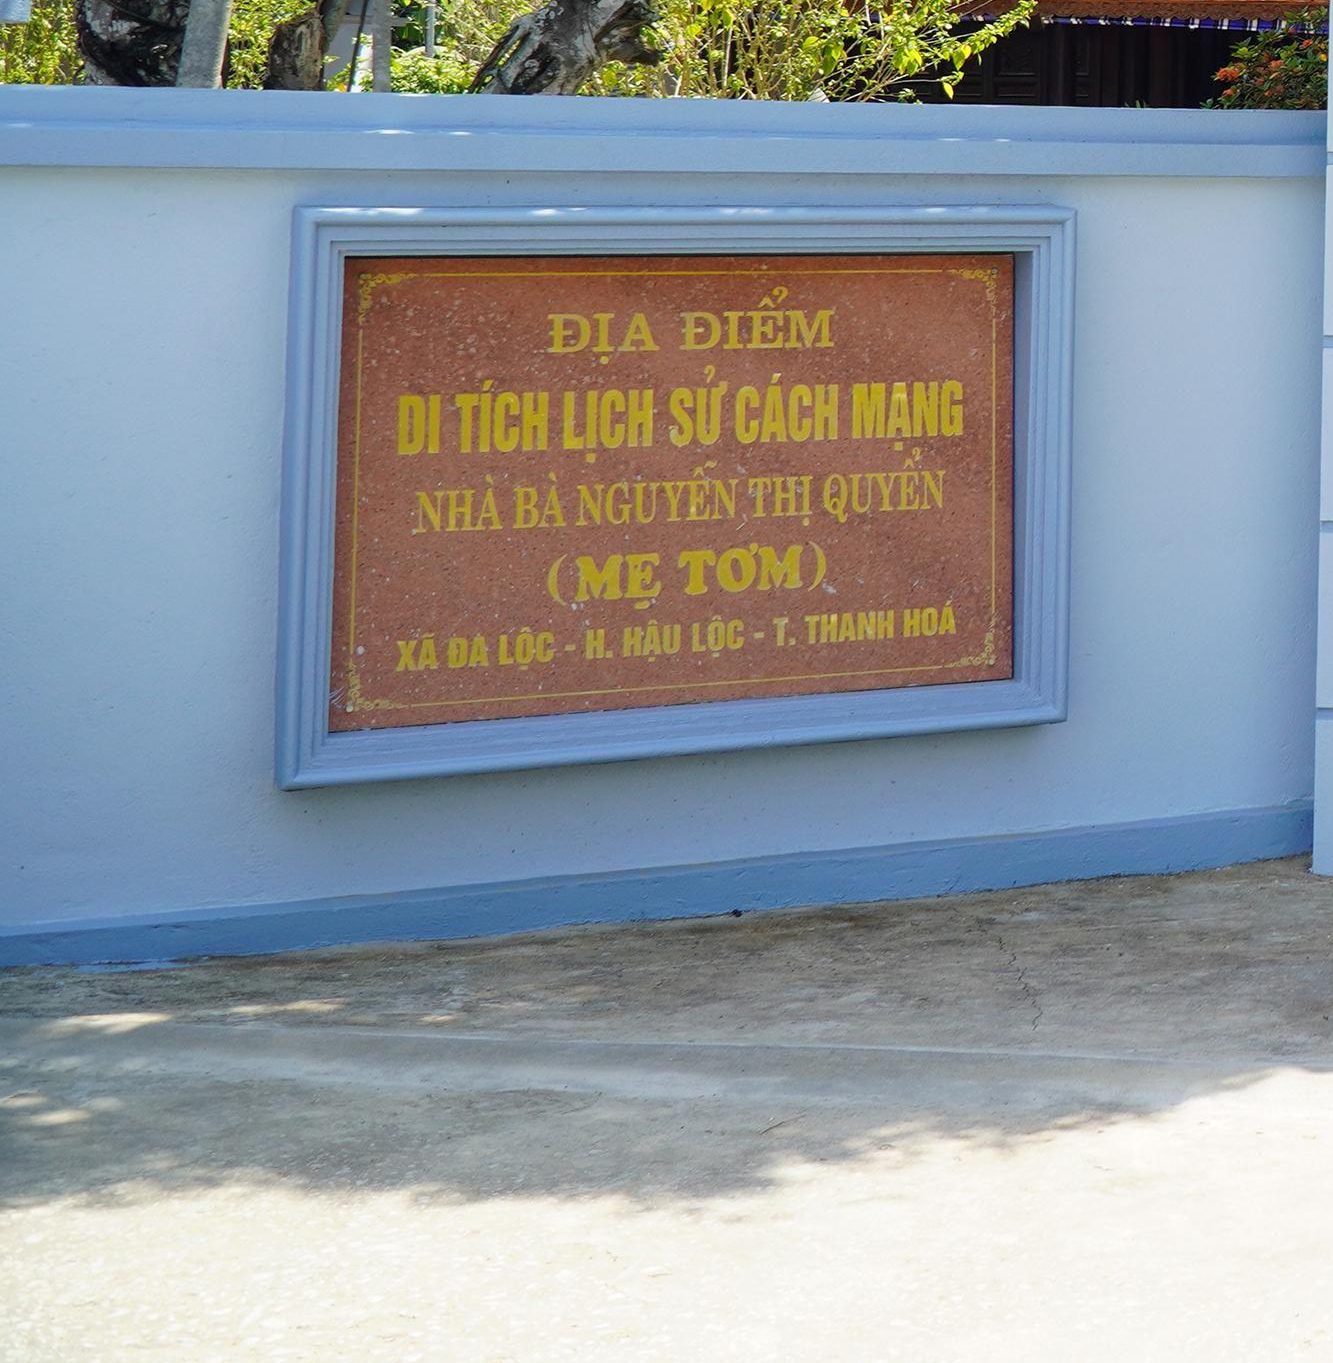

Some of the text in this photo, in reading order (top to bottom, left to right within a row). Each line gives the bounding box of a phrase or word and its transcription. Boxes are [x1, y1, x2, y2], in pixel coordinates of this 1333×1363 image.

[547, 286, 834, 364] ĐỊA ĐIỂM
[397, 364, 964, 462] DI TÍCH LỊCH SỬ CÁCH MẠNG
[412, 447, 947, 534] NHÀ BÀ NGUYỄN THỊ QUYỂN
[547, 541, 827, 610] (MẸ TƠM)
[395, 633, 438, 671] XÃ
[447, 631, 490, 668] ĐA
[498, 624, 556, 672] LỘC
[586, 626, 613, 661] H.
[623, 619, 682, 665] HẬU
[691, 614, 745, 660] LỘC
[773, 617, 796, 647] T.
[804, 610, 895, 645] THANH
[902, 599, 956, 636] HOÁ
